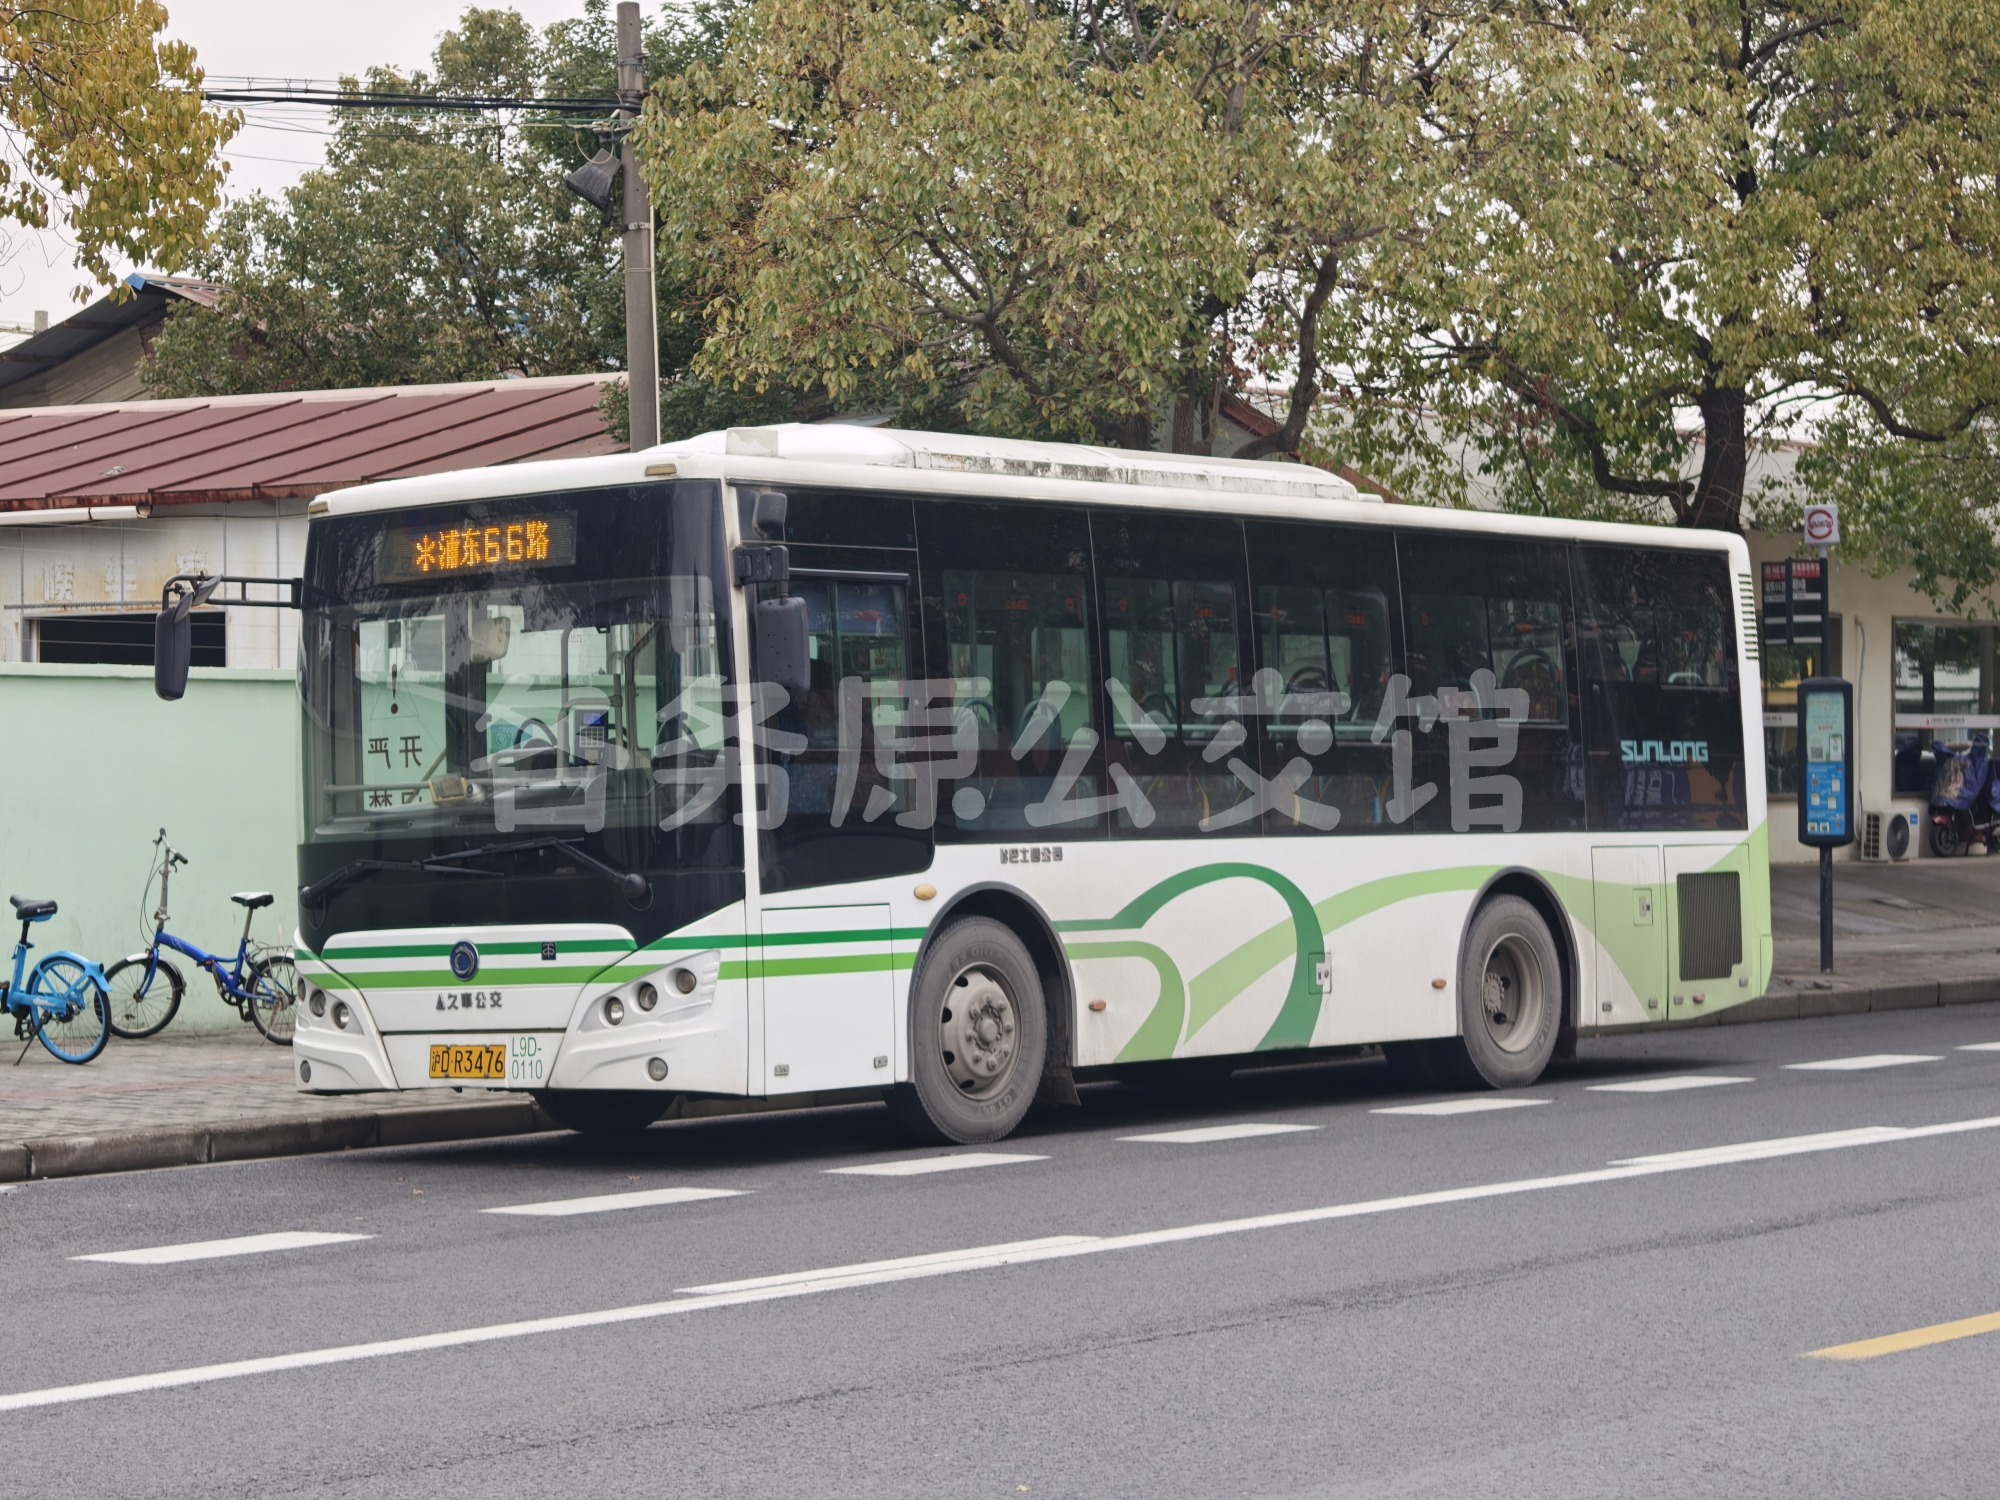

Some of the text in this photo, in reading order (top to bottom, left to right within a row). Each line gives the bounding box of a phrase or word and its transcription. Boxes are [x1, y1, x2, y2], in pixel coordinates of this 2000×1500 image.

[439, 521, 549, 569] 浦东66路
[1621, 739, 1709, 763] SUNLONG
[512, 1059, 543, 1080] 0110
